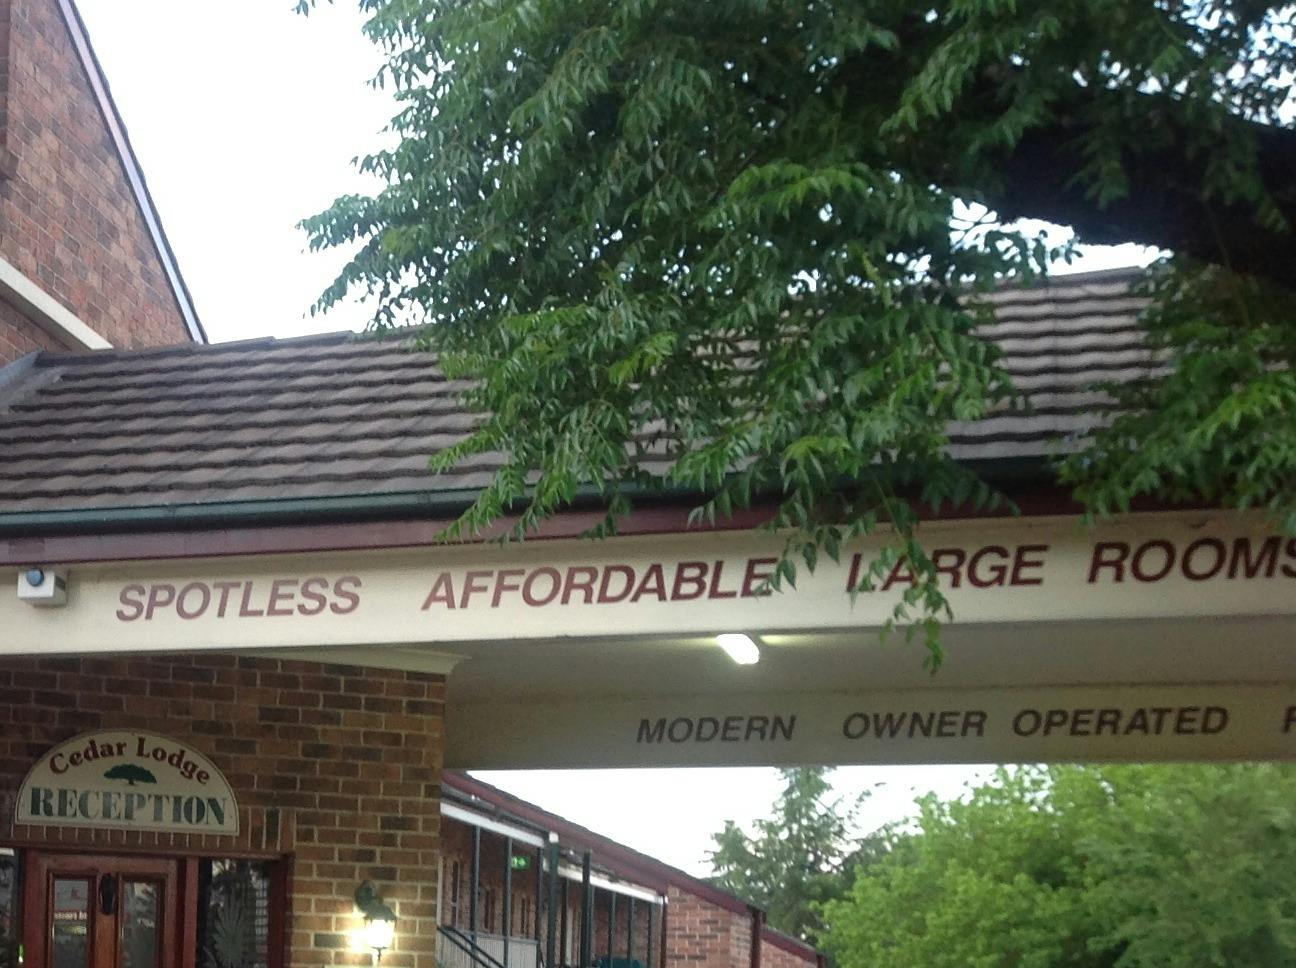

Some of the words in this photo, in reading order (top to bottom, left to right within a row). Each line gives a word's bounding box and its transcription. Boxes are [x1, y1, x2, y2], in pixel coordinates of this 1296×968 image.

[115, 575, 363, 622] SPOTLESS
[421, 556, 780, 612] AFFORDABLE
[846, 543, 1050, 593] LARGE
[636, 714, 797, 745] MODERN
[842, 710, 989, 740] OWNER
[1013, 705, 1231, 738] OPERATED
[49, 738, 128, 775] Cedar
[136, 736, 210, 785] Lodge
[30, 787, 226, 826] RECEPTION
